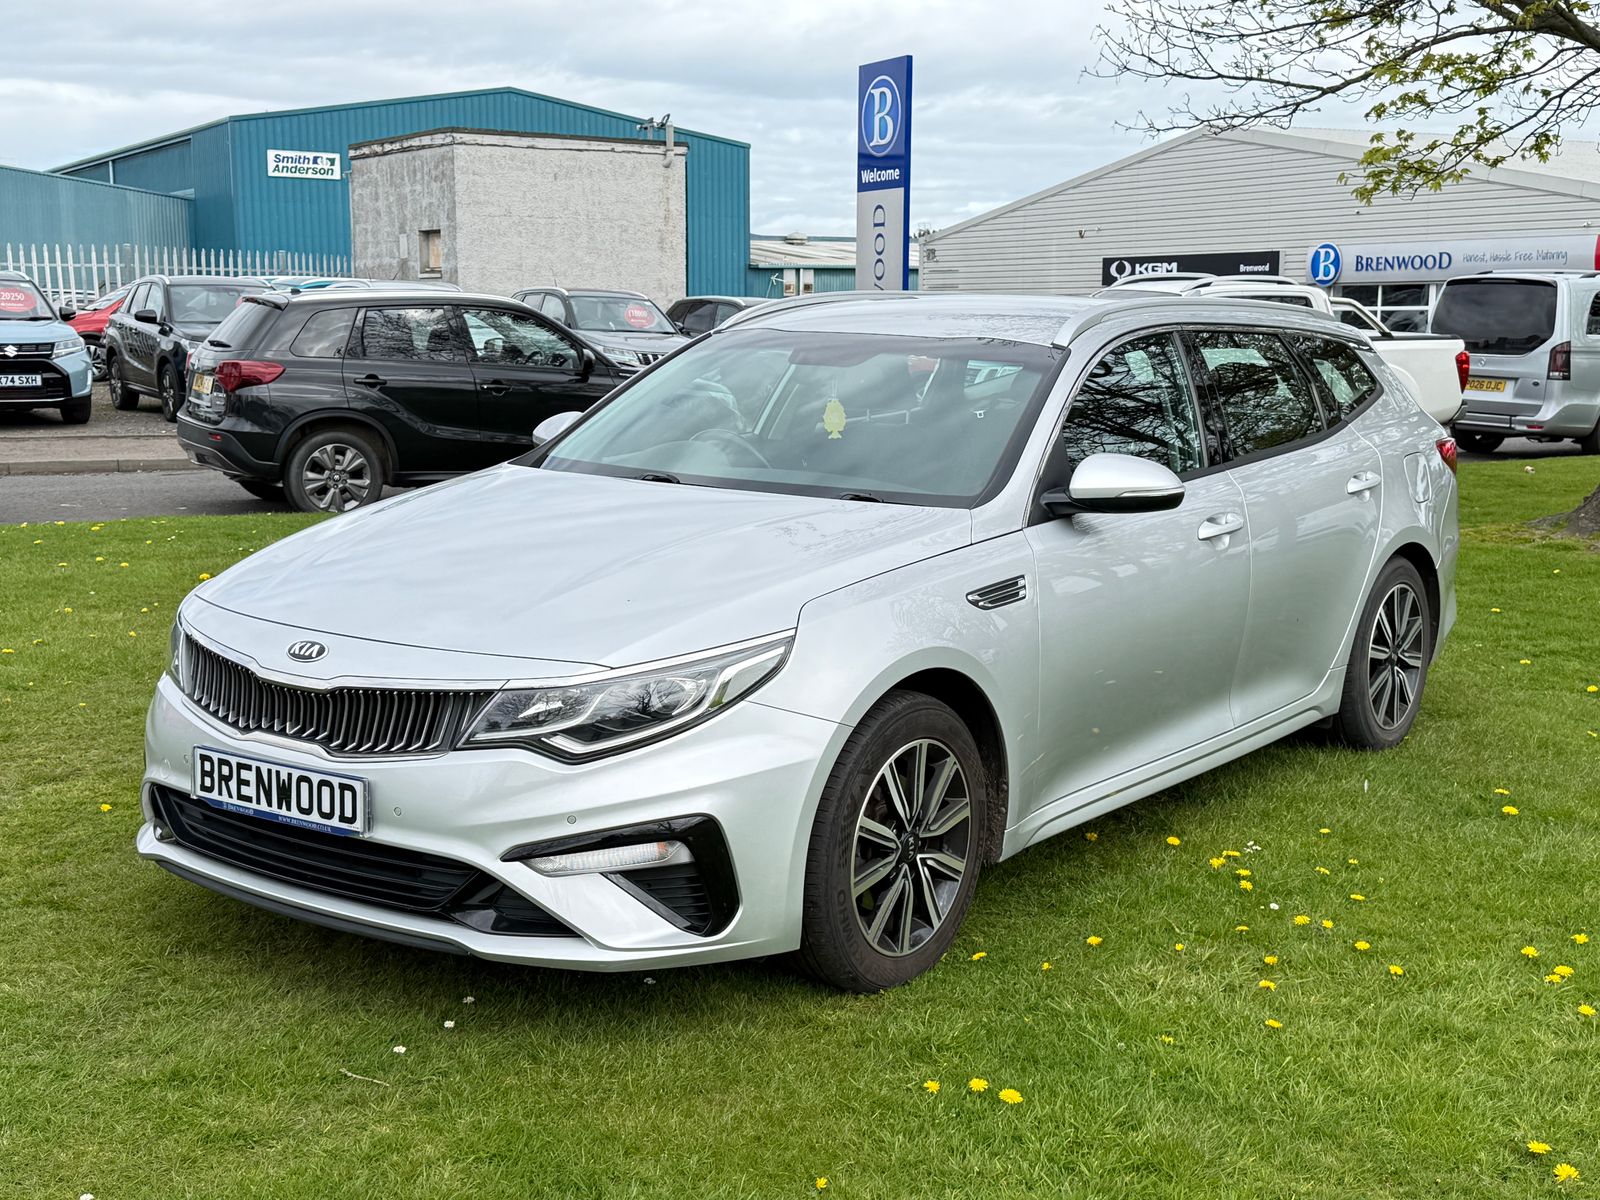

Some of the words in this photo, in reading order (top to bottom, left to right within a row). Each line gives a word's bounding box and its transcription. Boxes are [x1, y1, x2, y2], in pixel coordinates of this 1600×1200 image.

[869, 87, 894, 147] B
[273, 153, 311, 165] Smith
[272, 164, 334, 176] Anderson
[861, 168, 900, 184] Welcome
[1315, 248, 1336, 281] B
[1355, 252, 1453, 272] BRENWOOD
[1514, 251, 1534, 261] Free
[1536, 249, 1568, 265] Motoring
[1135, 262, 1178, 275] KGM
[1239, 262, 1270, 273] Brenwood
[18, 376, 38, 385] SXH
[290, 642, 321, 658] KIA
[199, 753, 357, 825] BRENWOOD
